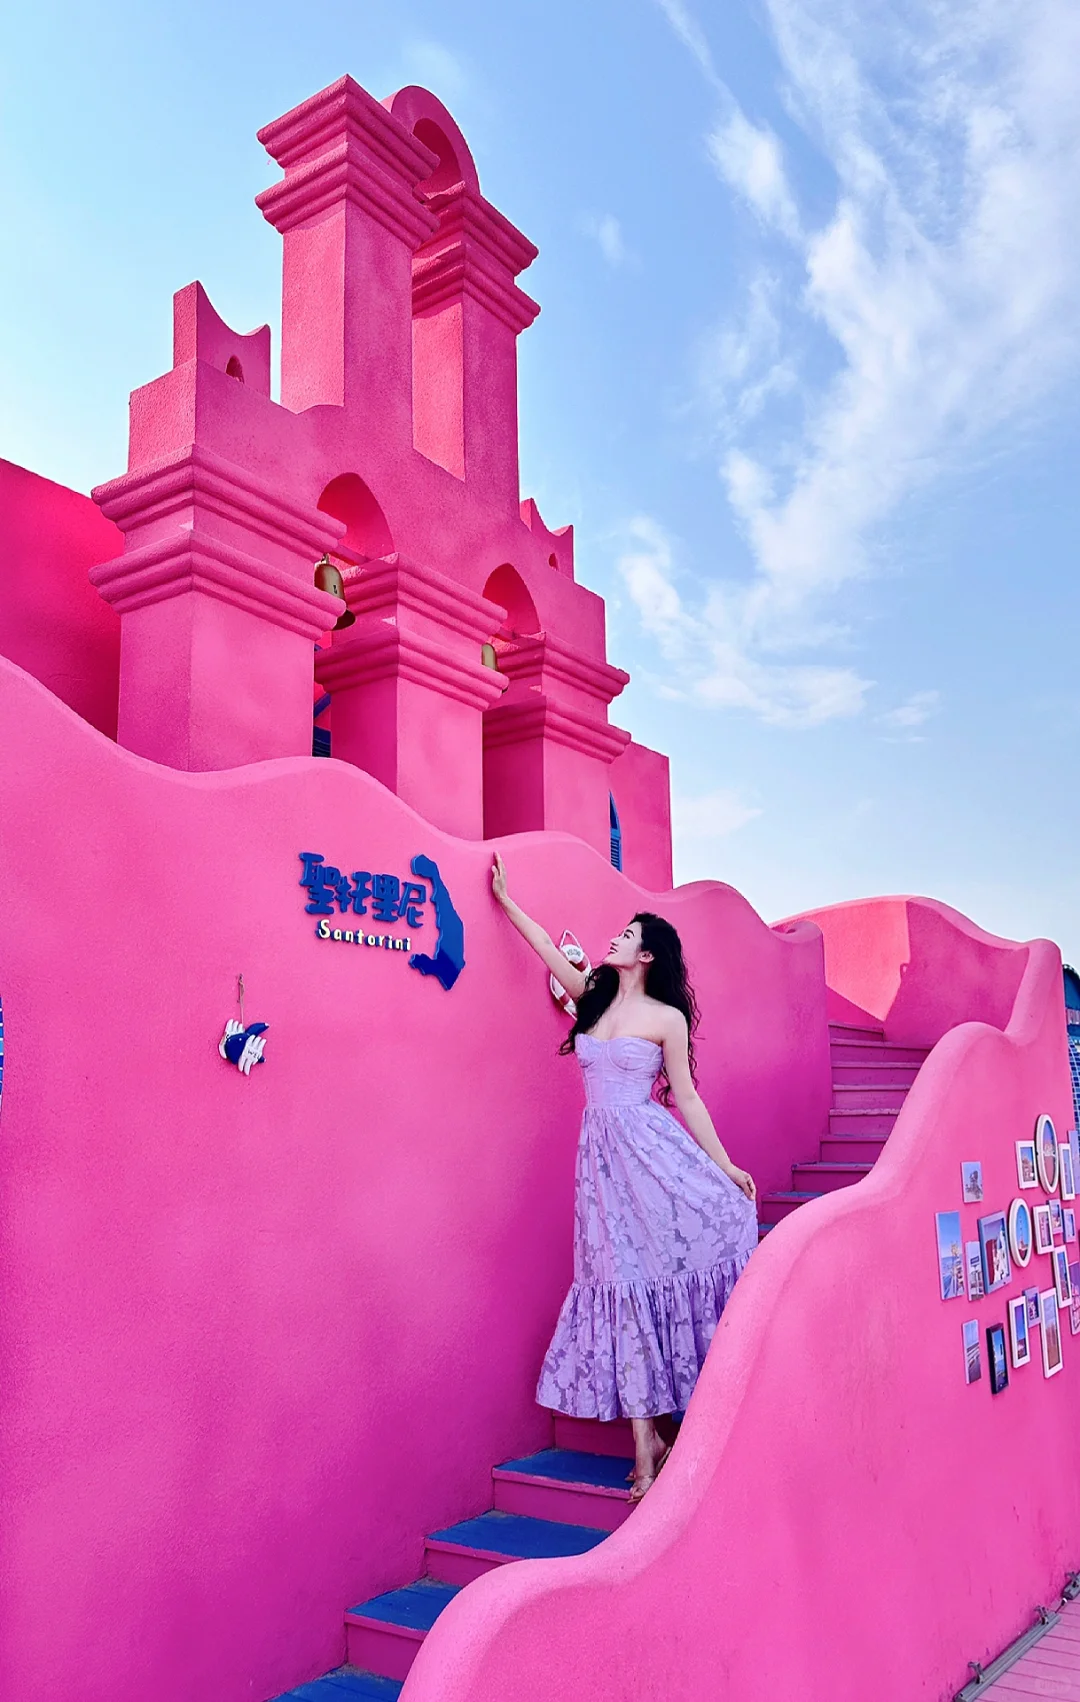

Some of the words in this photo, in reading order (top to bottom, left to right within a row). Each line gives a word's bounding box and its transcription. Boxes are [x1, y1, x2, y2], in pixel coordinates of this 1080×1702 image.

[299, 852, 426, 928] 聖托里尼
[316, 919, 411, 951] Santorini
